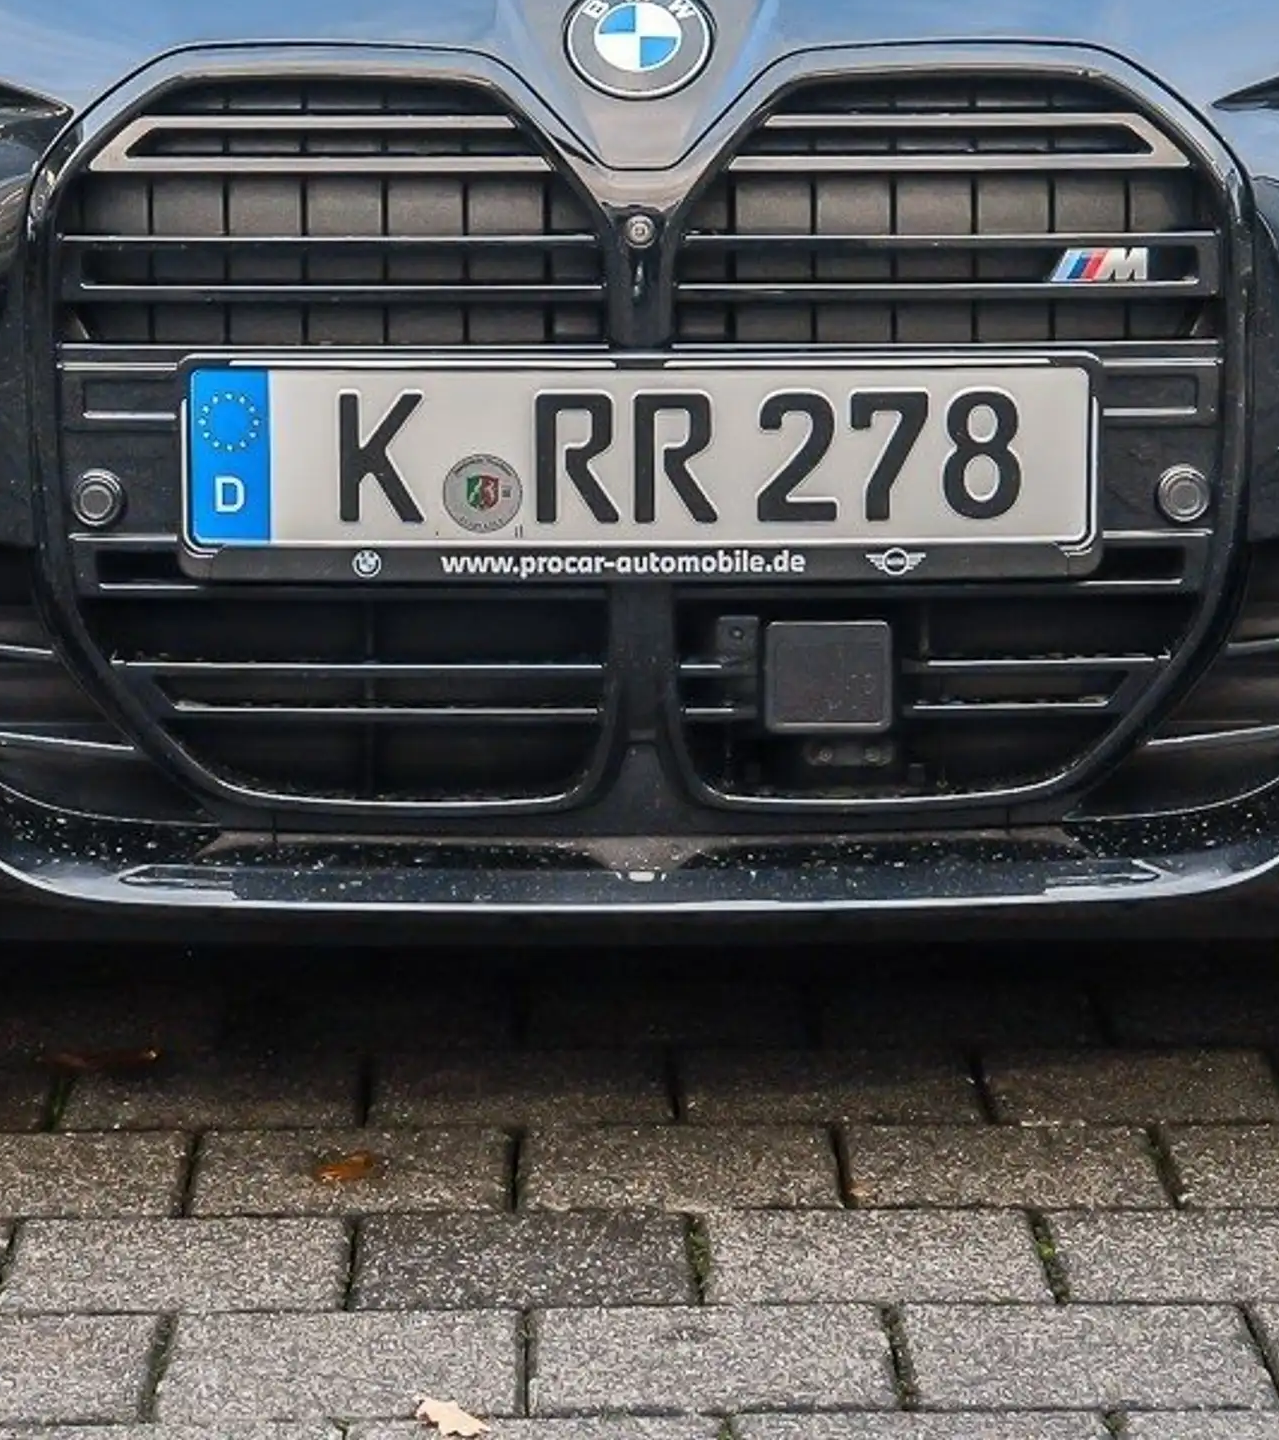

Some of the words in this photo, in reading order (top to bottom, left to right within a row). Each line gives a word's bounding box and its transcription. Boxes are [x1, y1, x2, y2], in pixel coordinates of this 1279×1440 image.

[338, 392, 425, 525] K
[534, 392, 719, 525] RR
[755, 391, 1023, 524] 278
[214, 476, 245, 513] D
[439, 548, 807, 580] www.procar-automobile.de
